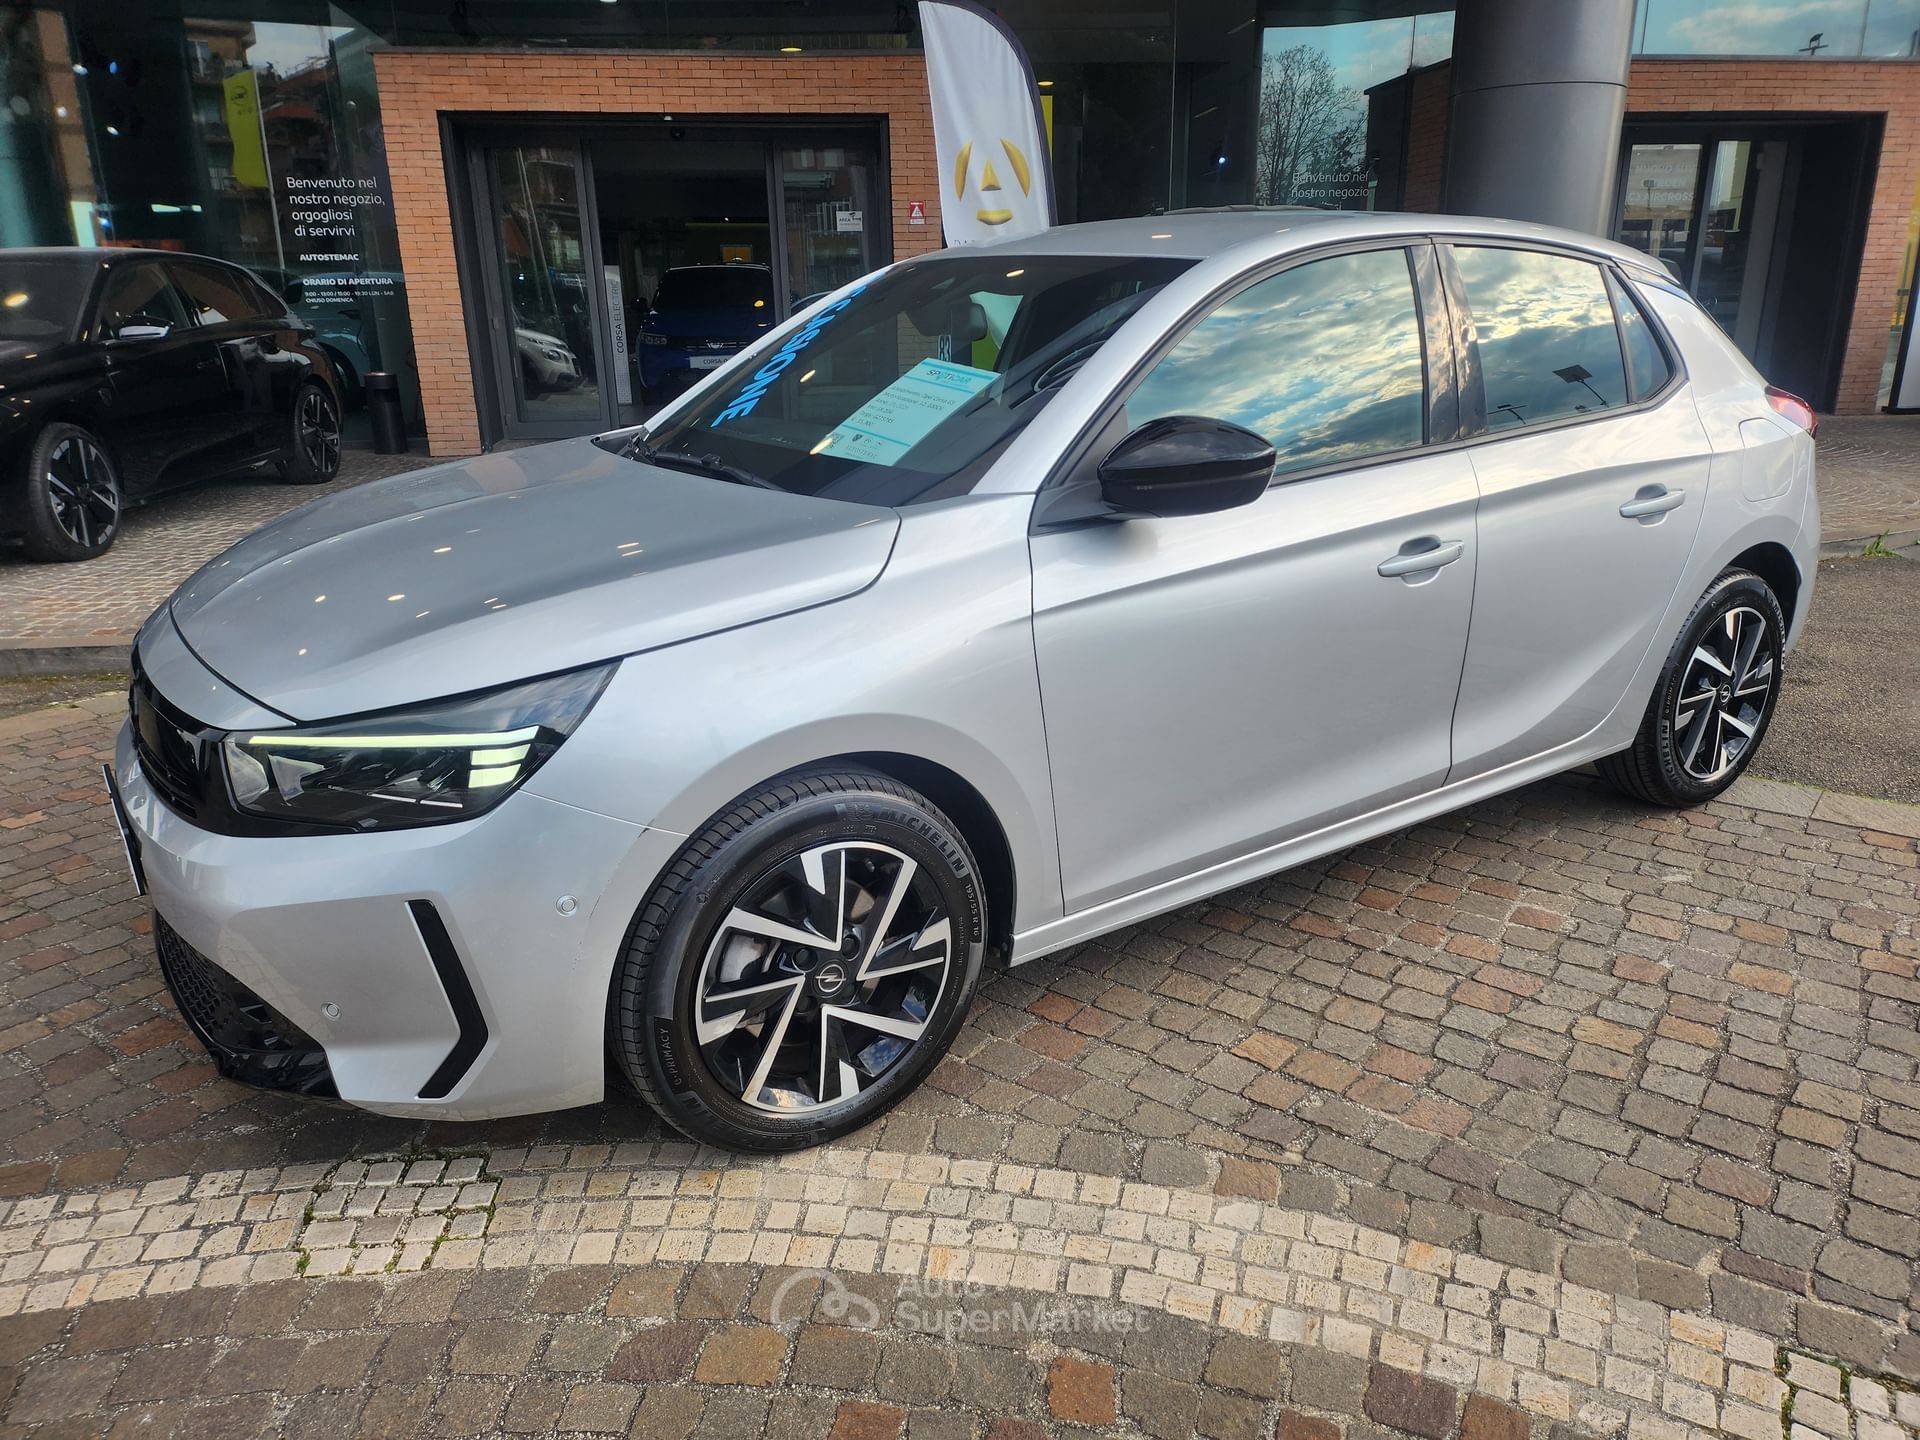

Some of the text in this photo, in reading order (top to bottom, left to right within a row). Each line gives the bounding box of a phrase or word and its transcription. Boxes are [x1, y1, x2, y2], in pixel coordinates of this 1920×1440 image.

[286, 176, 377, 188] Benvenuto nel
[1292, 171, 1369, 183] Benvenuto nel
[1291, 187, 1326, 199] nostro
[289, 193, 386, 207] nostro negozio,
[291, 208, 353, 223] orgogliosi
[294, 225, 356, 236] di servirvi
[300, 253, 360, 261] AUTOSTEMAC
[302, 278, 336, 286] ORARIO
[348, 277, 394, 285] APERTURA
[615, 323, 625, 354] CORSA
[1662, 725, 1682, 786] MICHELIN
[880, 810, 966, 873] MICHELIN
